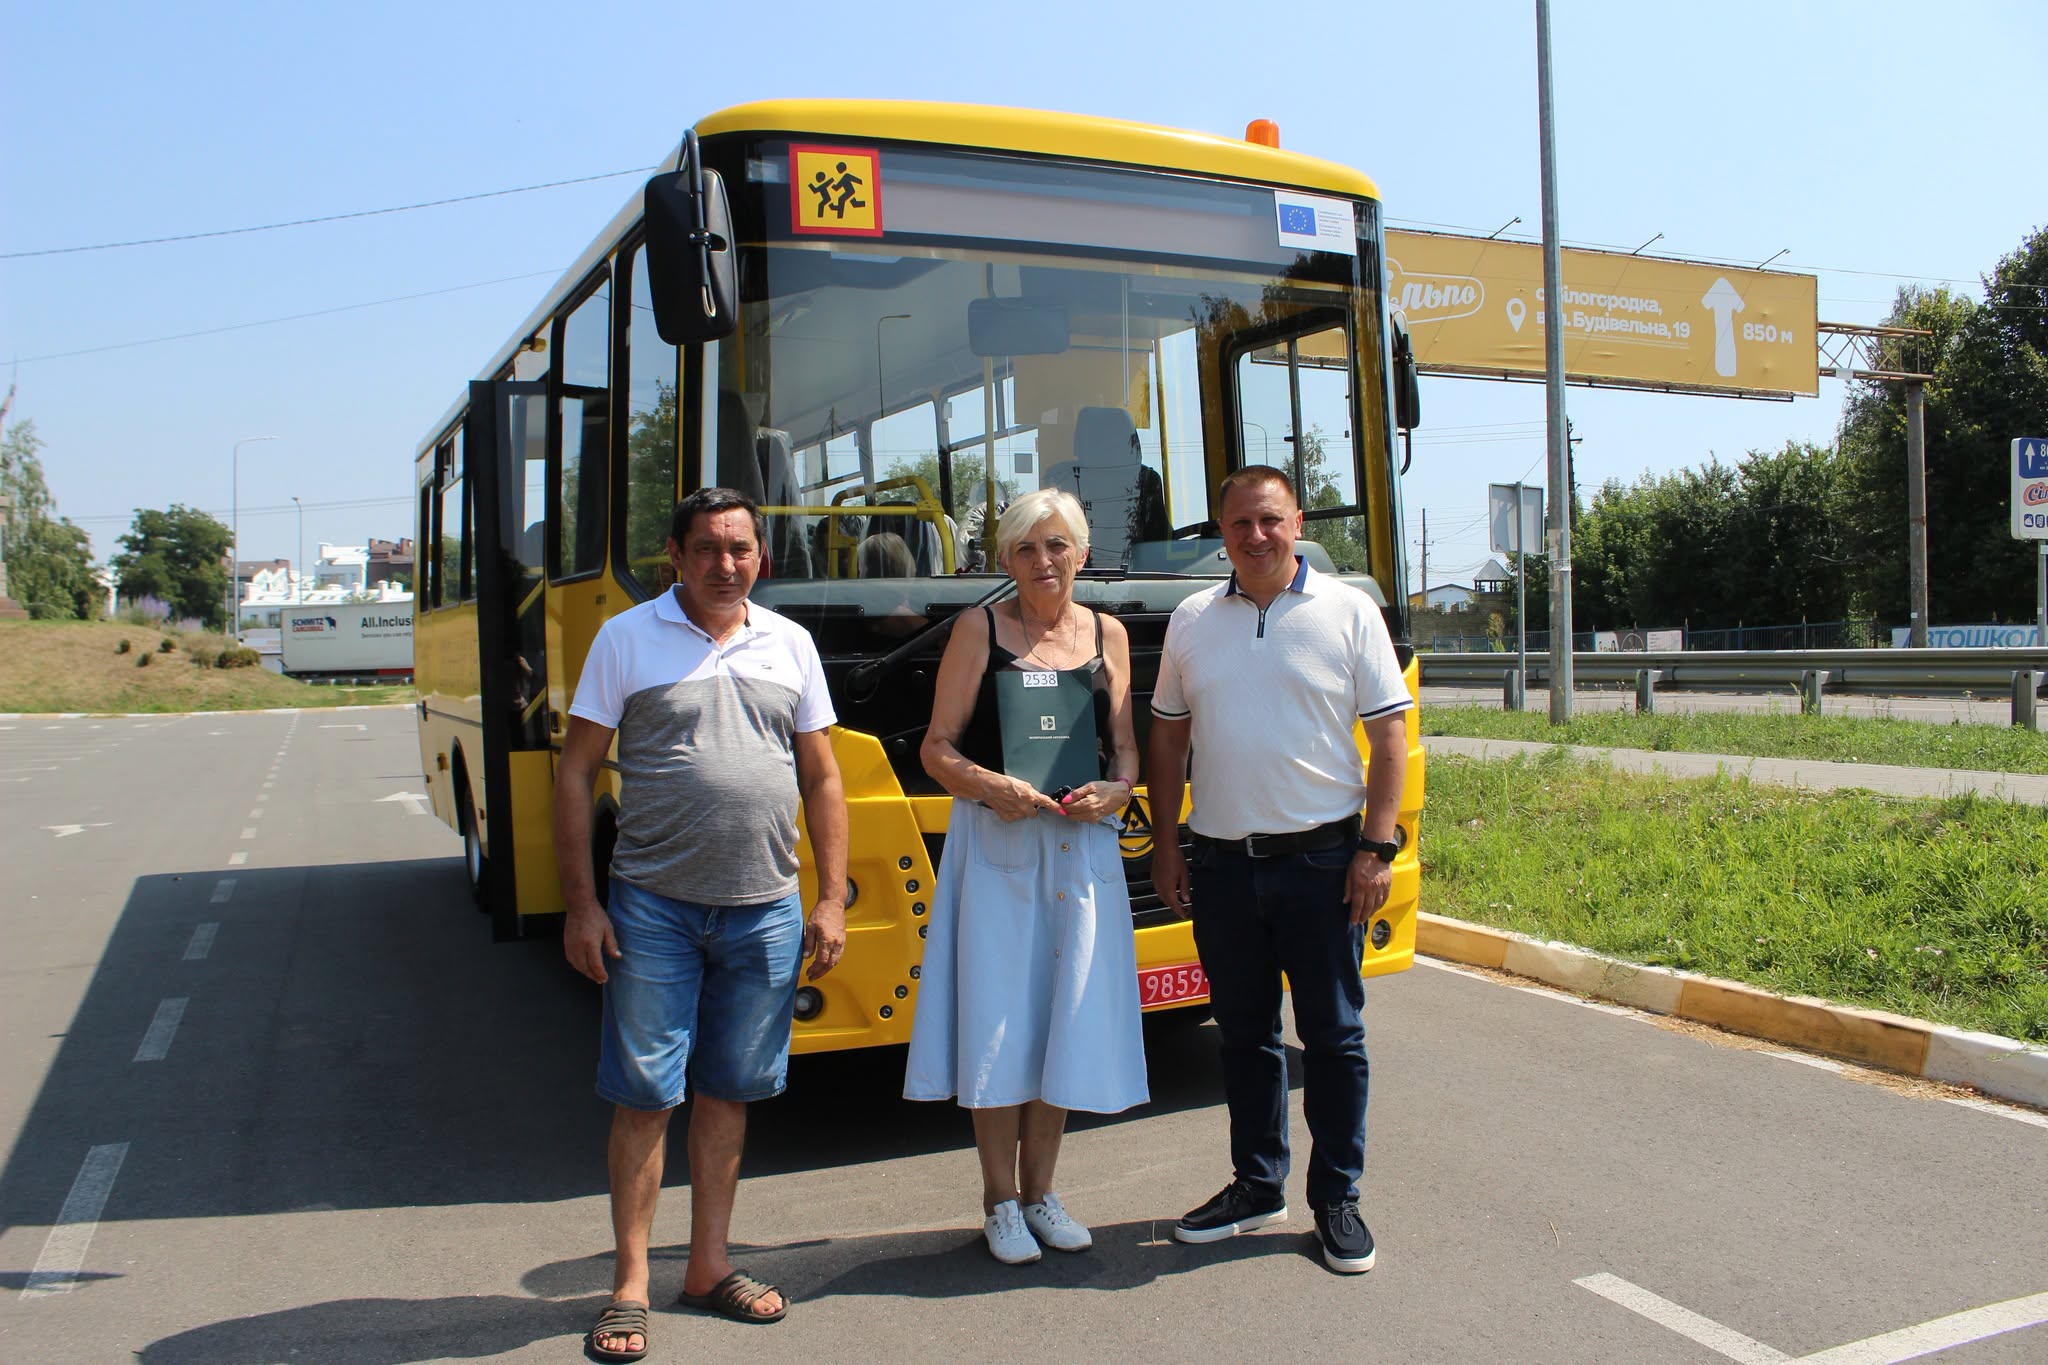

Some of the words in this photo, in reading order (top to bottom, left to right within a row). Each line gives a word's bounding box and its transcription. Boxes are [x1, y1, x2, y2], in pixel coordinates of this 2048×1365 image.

[1560, 285, 1662, 315] ілогородка,
[1573, 311, 1671, 339] Будівельна,
[1673, 321, 1690, 338] 19
[1743, 322, 1777, 342] 850
[1781, 330, 1793, 344] м
[1025, 674, 1056, 685] 2538
[1146, 968, 1202, 1001] 9859
